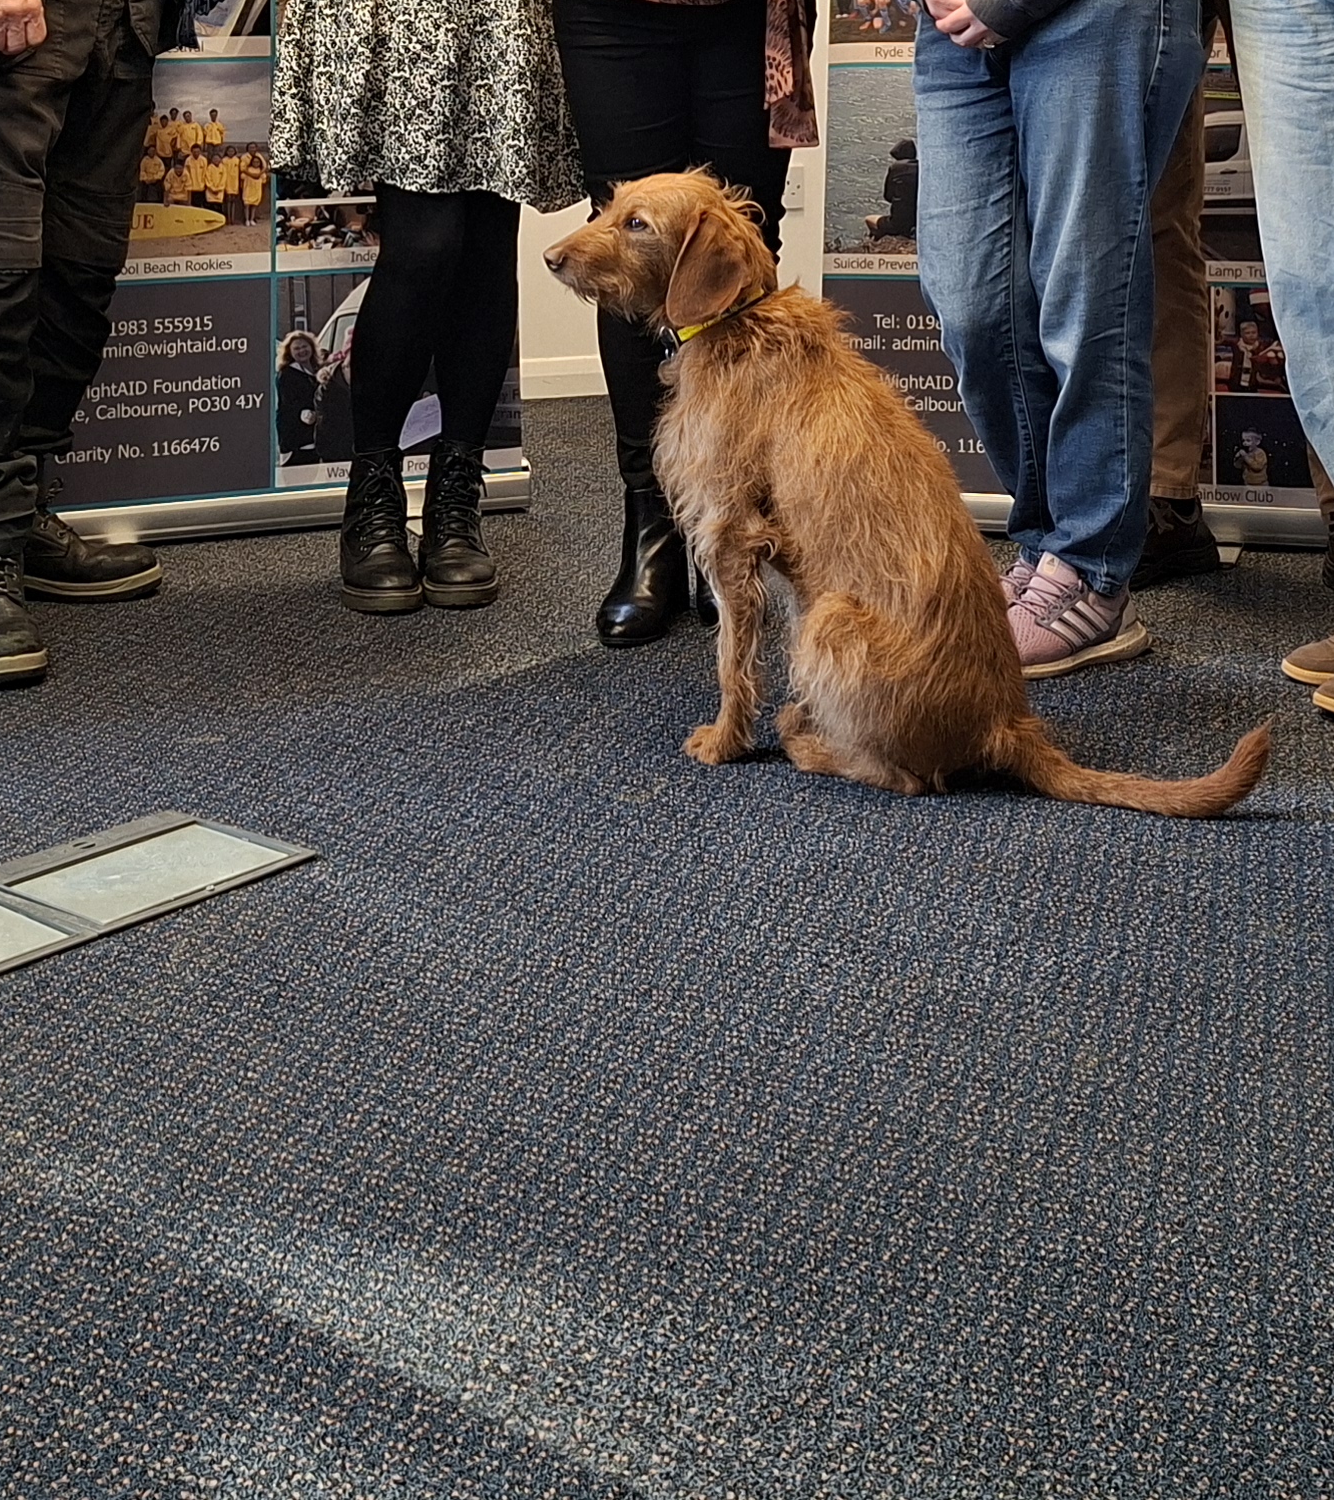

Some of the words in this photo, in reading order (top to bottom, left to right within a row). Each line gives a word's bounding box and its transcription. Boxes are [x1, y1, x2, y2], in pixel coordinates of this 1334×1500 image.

[875, 46, 904, 59] Ryde
[143, 261, 180, 274] Beach
[185, 259, 232, 272] Rookies
[833, 257, 874, 269] Suicide
[1208, 264, 1242, 279] Lamp
[154, 315, 212, 334] 555915
[873, 314, 900, 329] Tel:
[153, 375, 241, 395] Foundation
[95, 402, 182, 420] Calbourne,
[189, 395, 230, 414] PO30
[235, 393, 264, 409] 4JY
[118, 444, 145, 459] No.
[152, 436, 220, 457] 1166476
[1246, 490, 1274, 503] Club
